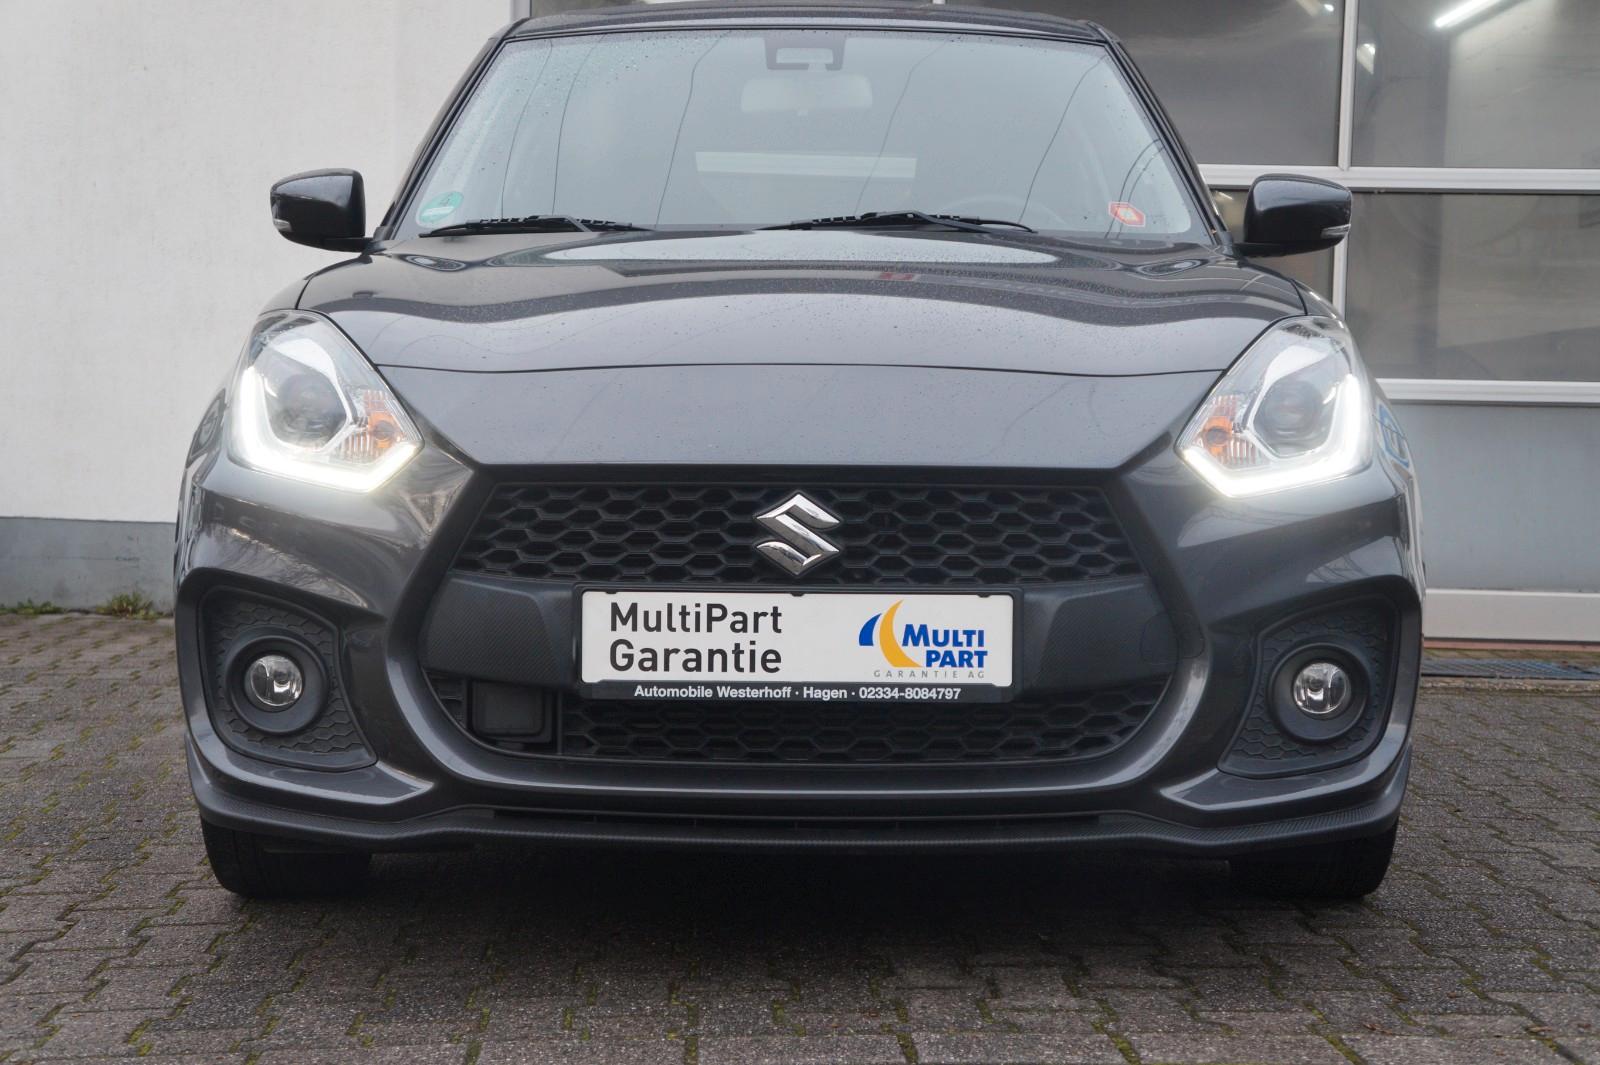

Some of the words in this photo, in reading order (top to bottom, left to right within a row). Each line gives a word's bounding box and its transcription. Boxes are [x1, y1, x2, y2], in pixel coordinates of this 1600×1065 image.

[610, 602, 782, 634] MultiPart
[902, 624, 985, 647] MULTI
[609, 638, 782, 673] Garantie
[926, 650, 988, 668] PART
[873, 670, 958, 679] GARANTIE
[968, 670, 985, 679] AG
[634, 685, 713, 698] Automobile
[716, 685, 792, 699] Westerhoff
[803, 686, 848, 701] Hagen
[858, 687, 962, 700] 02334-8084797
